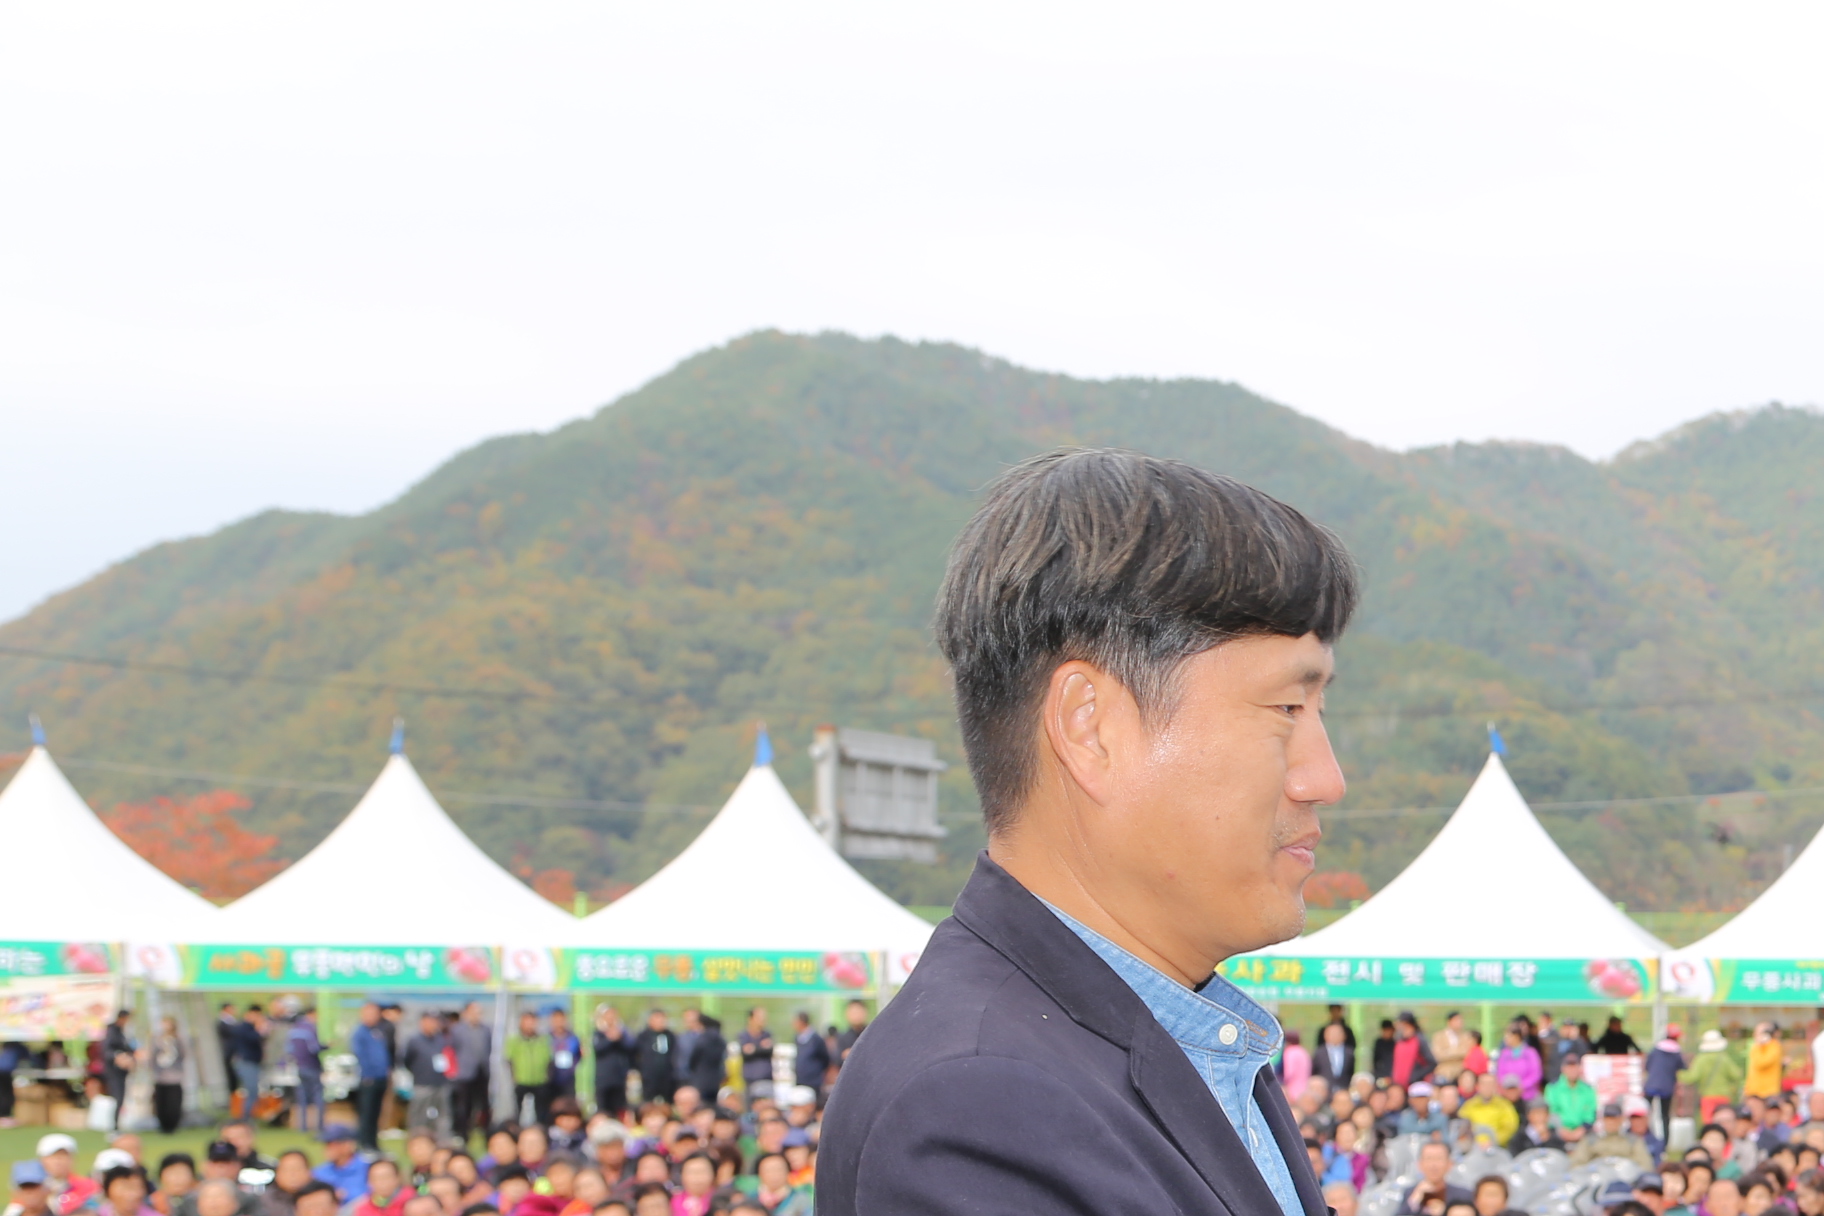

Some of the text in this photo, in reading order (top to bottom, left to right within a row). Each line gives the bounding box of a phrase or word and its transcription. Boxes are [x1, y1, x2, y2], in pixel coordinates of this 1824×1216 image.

[702, 956, 775, 984] 살맛나는
[1216, 958, 1538, 988] 사과 전시 및 판매장
